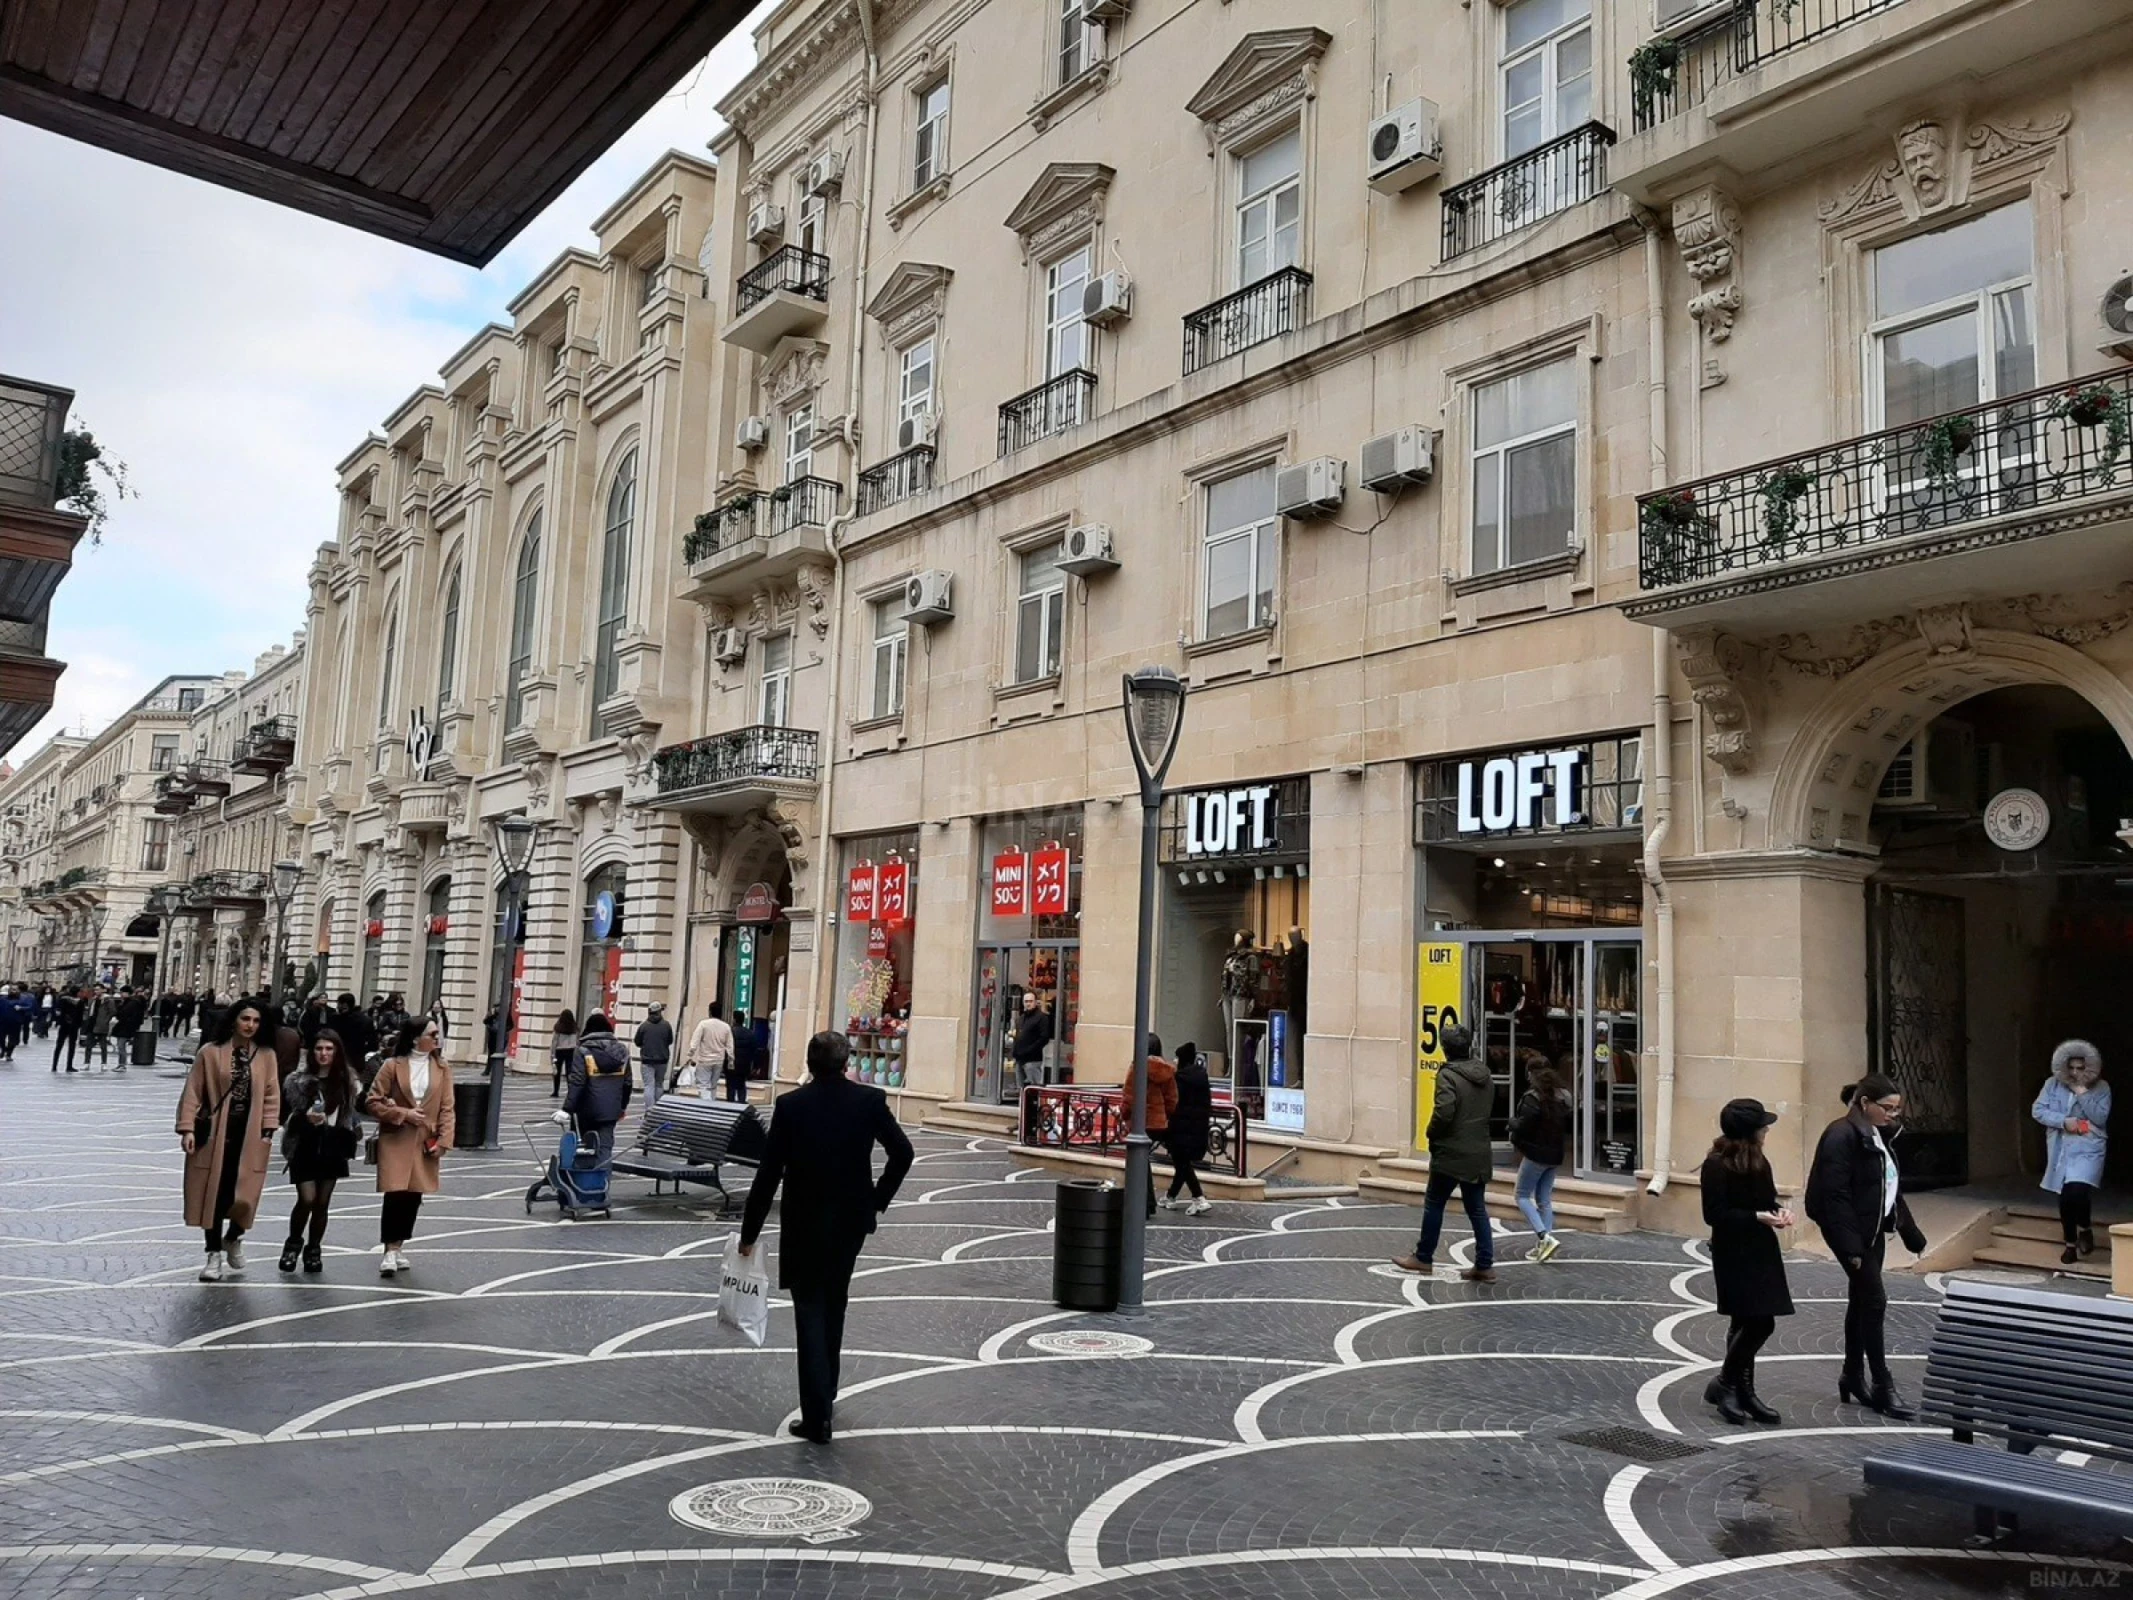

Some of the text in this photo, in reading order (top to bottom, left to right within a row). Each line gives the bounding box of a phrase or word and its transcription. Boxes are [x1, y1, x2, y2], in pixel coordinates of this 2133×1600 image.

[1458, 751, 1579, 833] LOFT
[1186, 788, 1270, 854] LOFT
[995, 865, 1022, 883] MINI
[1036, 860, 1061, 882] メイ
[851, 877, 873, 892] MINI
[883, 873, 902, 892] メイ
[883, 894, 902, 911] ソウ
[1036, 883, 1061, 904] ソウ
[1429, 948, 1452, 964] LOFT
